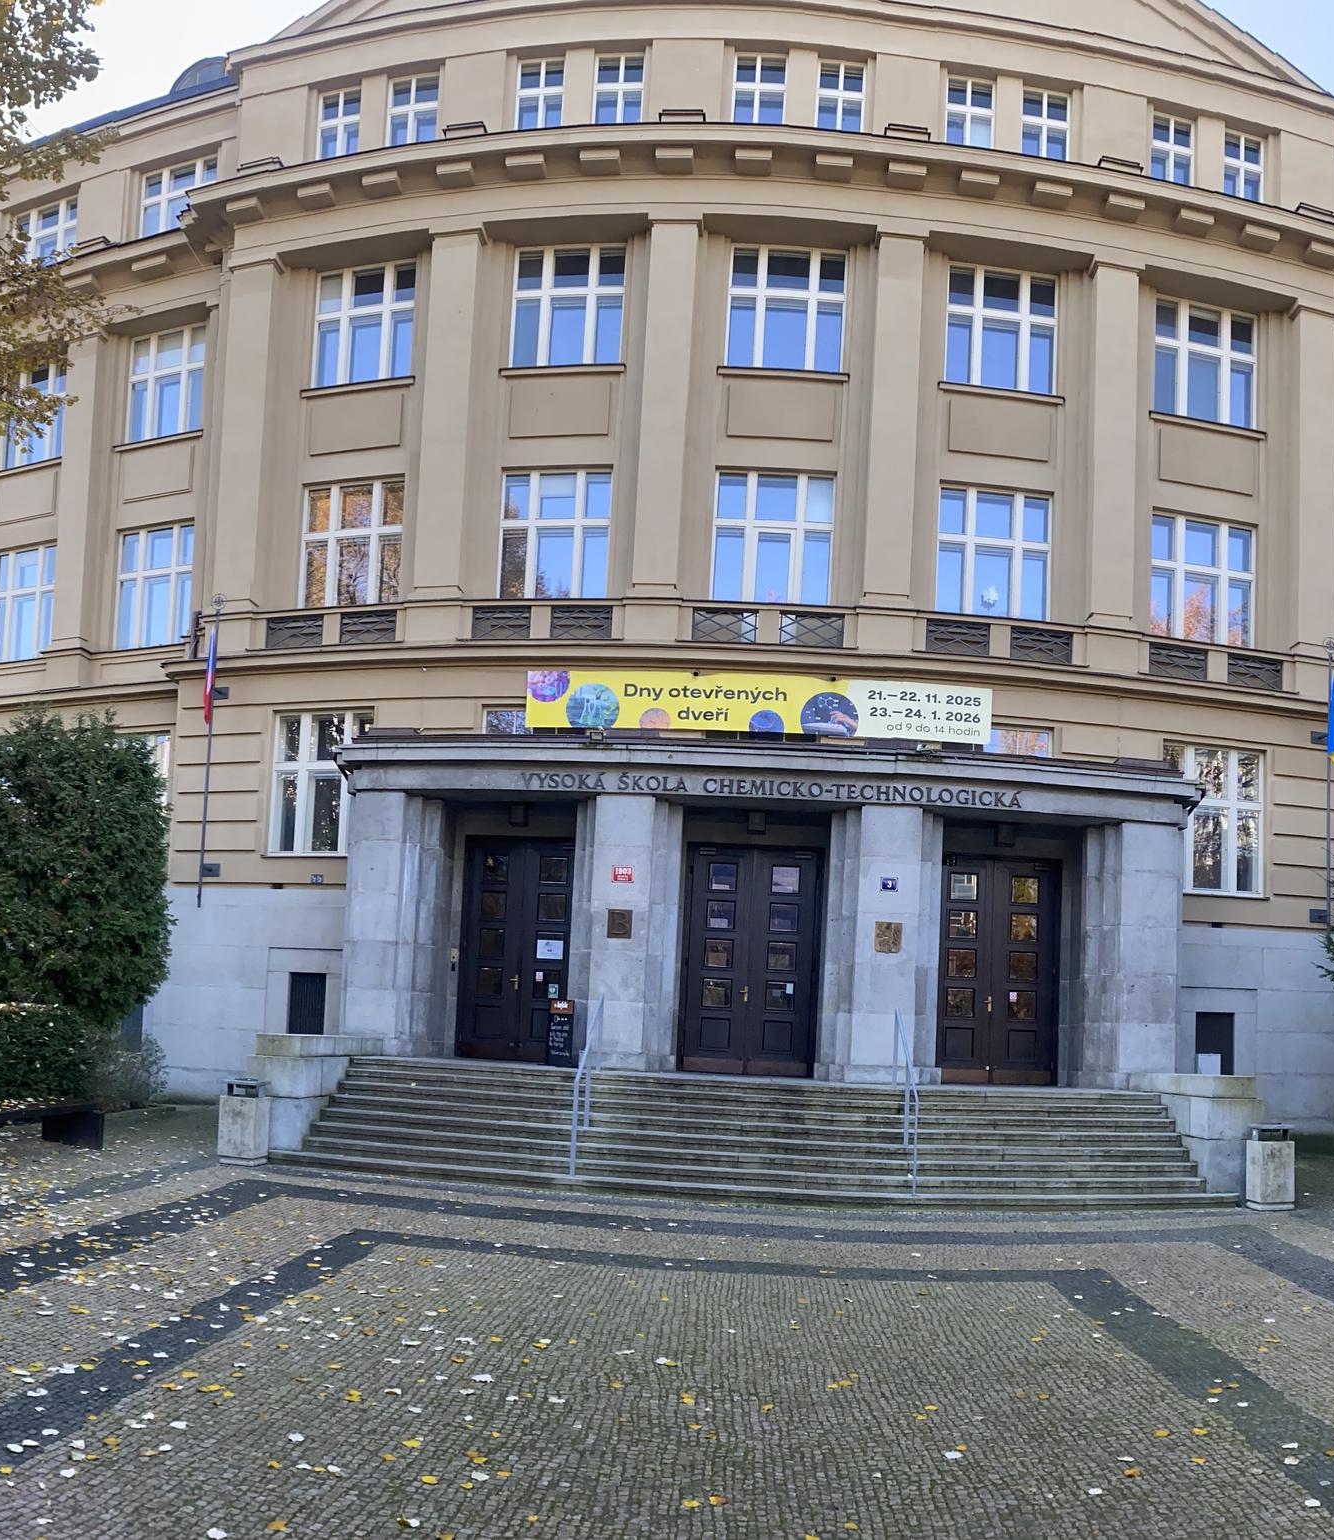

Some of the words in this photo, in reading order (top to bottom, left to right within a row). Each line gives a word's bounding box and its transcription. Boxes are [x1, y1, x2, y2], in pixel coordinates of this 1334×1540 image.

[623, 683, 664, 701] Dny
[668, 685, 788, 704] otevřených
[925, 693, 941, 703] 11.
[946, 695, 981, 707] 2025
[677, 707, 729, 721] dveří
[931, 711, 941, 720] 1.
[945, 712, 981, 723] 2026
[887, 721, 902, 731] od
[906, 723, 912, 731] 9
[915, 723, 930, 733] do
[935, 726, 945, 734] 14
[948, 726, 980, 736] hodin
[521, 772, 606, 790] VYSOKÁ
[617, 771, 688, 793] ŠKOLA
[702, 778, 1022, 808] CHEMICKO-TECHNOLOGICKÁ
[887, 880, 892, 888] 3
